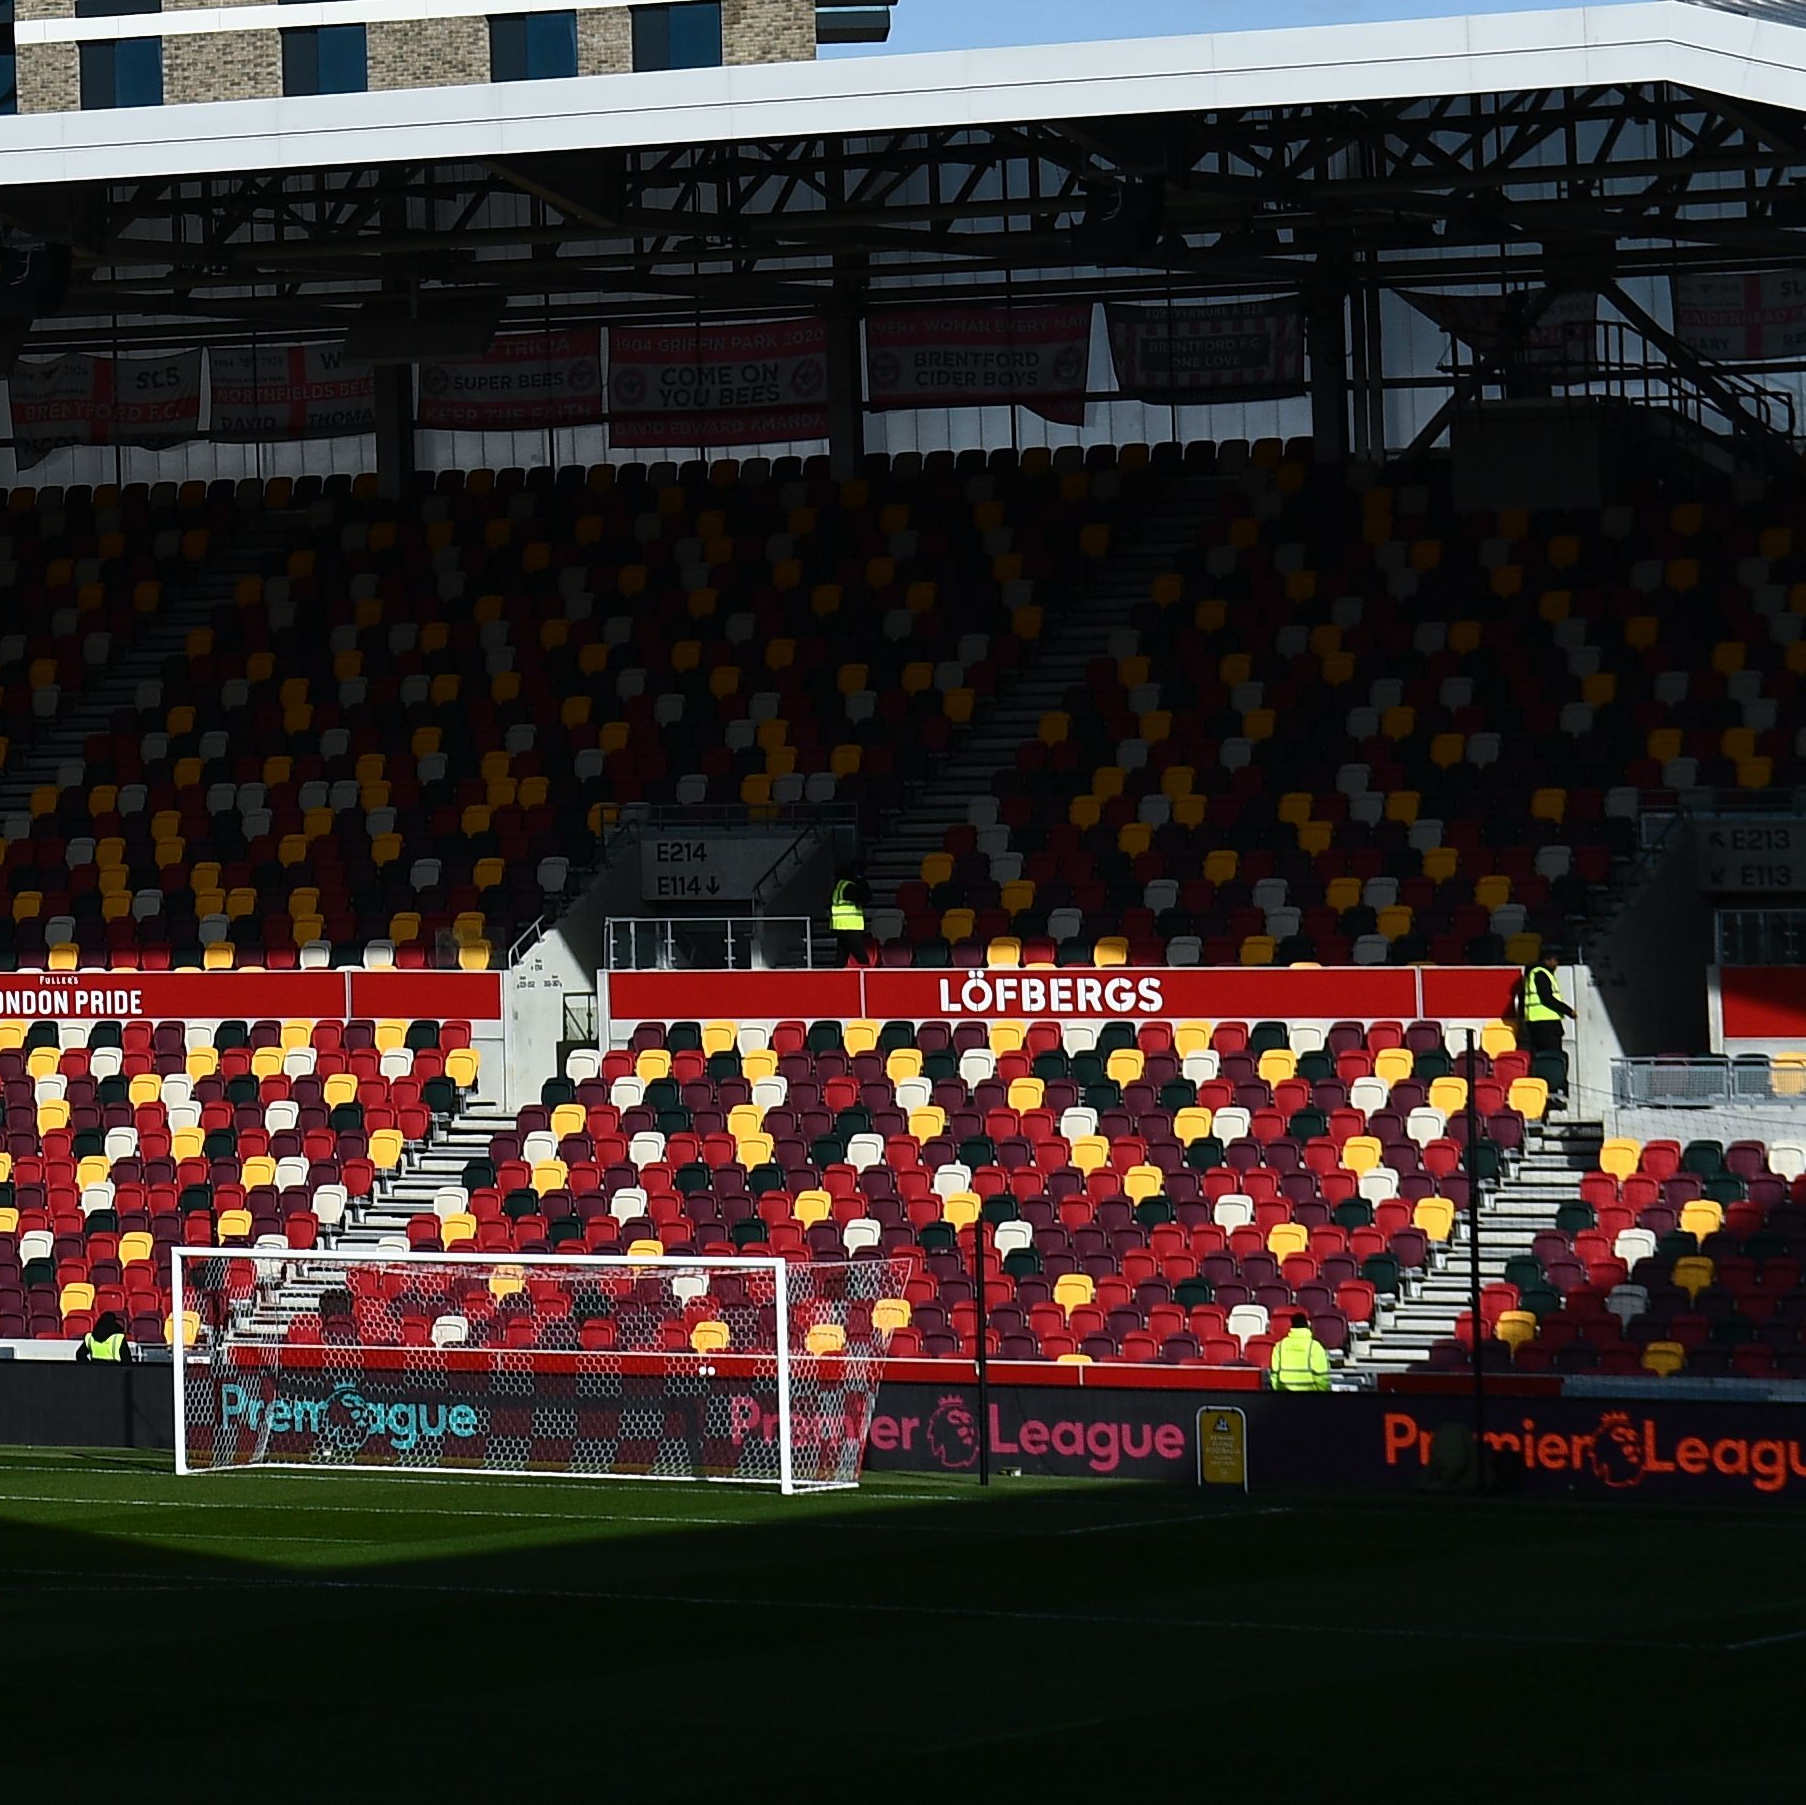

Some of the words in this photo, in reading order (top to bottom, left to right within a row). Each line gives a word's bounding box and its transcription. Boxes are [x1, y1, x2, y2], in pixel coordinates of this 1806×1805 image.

[869, 320, 917, 335] EVERY
[923, 318, 990, 332] WOMAN
[996, 318, 1048, 332] EVERY
[658, 335, 725, 353] GRIFFIN
[733, 332, 778, 349] PARK
[783, 327, 825, 348] 2020
[1148, 338, 1236, 353] BRENTFORD
[914, 351, 1040, 367] BRENTFORD
[1205, 354, 1241, 366] LOVE
[454, 375, 512, 391] SUPER
[518, 372, 564, 389] BEES
[659, 365, 731, 387] COME
[742, 362, 779, 382] ON
[916, 371, 977, 387] CIDER
[983, 370, 1038, 386] BOYS
[217, 384, 333, 404] NORTHFIELDS
[659, 387, 711, 409] YOU
[723, 383, 781, 406] BEES
[25, 402, 141, 421] BRENTFORD
[148, 403, 180, 420] F.C.
[221, 416, 276, 432] DAVID
[308, 409, 374, 427] THOMA
[425, 405, 477, 422] KEEP
[486, 407, 524, 422] THE
[531, 403, 591, 420] FAITH
[615, 421, 662, 436] DAVID
[670, 418, 743, 435] EDWARD
[751, 413, 825, 431] AMANDA
[1732, 829, 1791, 851] E213
[657, 842, 708, 862] E214
[1741, 864, 1792, 886] E113
[657, 876, 701, 896] E114
[939, 970, 1164, 1012] LÖFBERGS
[75, 989, 143, 1015] PRIDE
[989, 1403, 1185, 1472] League
[1384, 1411, 1591, 1471] Prmier
